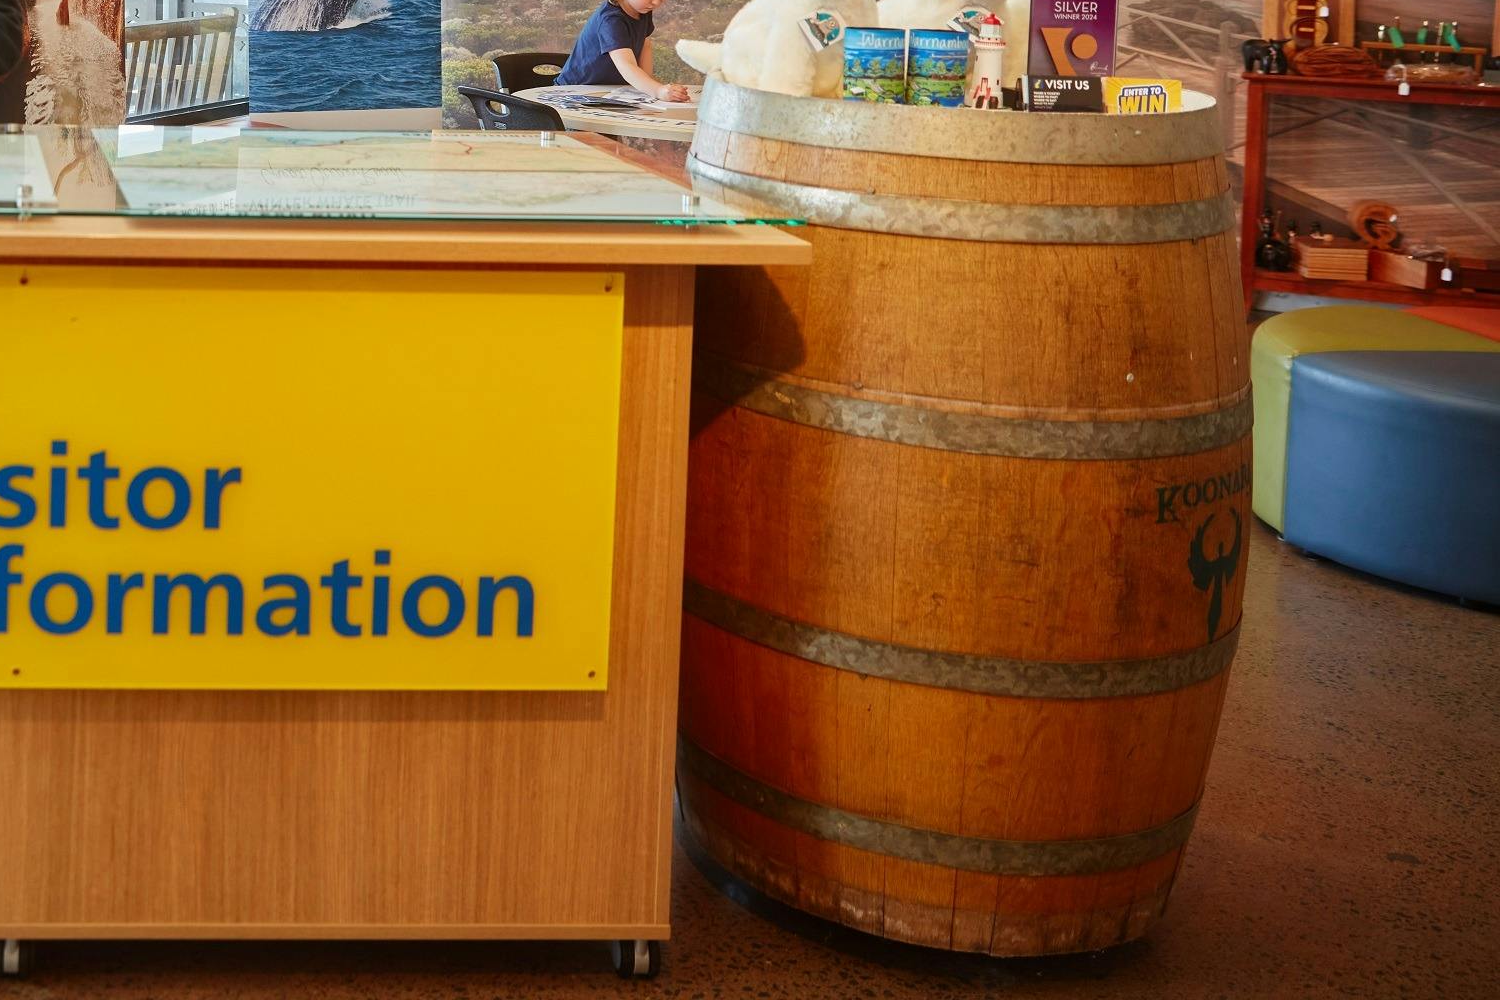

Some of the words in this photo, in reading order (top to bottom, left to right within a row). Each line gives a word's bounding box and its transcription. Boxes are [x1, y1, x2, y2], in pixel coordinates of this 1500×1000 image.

[1054, 1, 1098, 13] SILVER
[1045, 79, 1072, 90] VISIT
[1074, 80, 1090, 91] US
[1124, 87, 1149, 97] ENTER
[1150, 86, 1162, 95] TO
[1120, 93, 1165, 114] WIN
